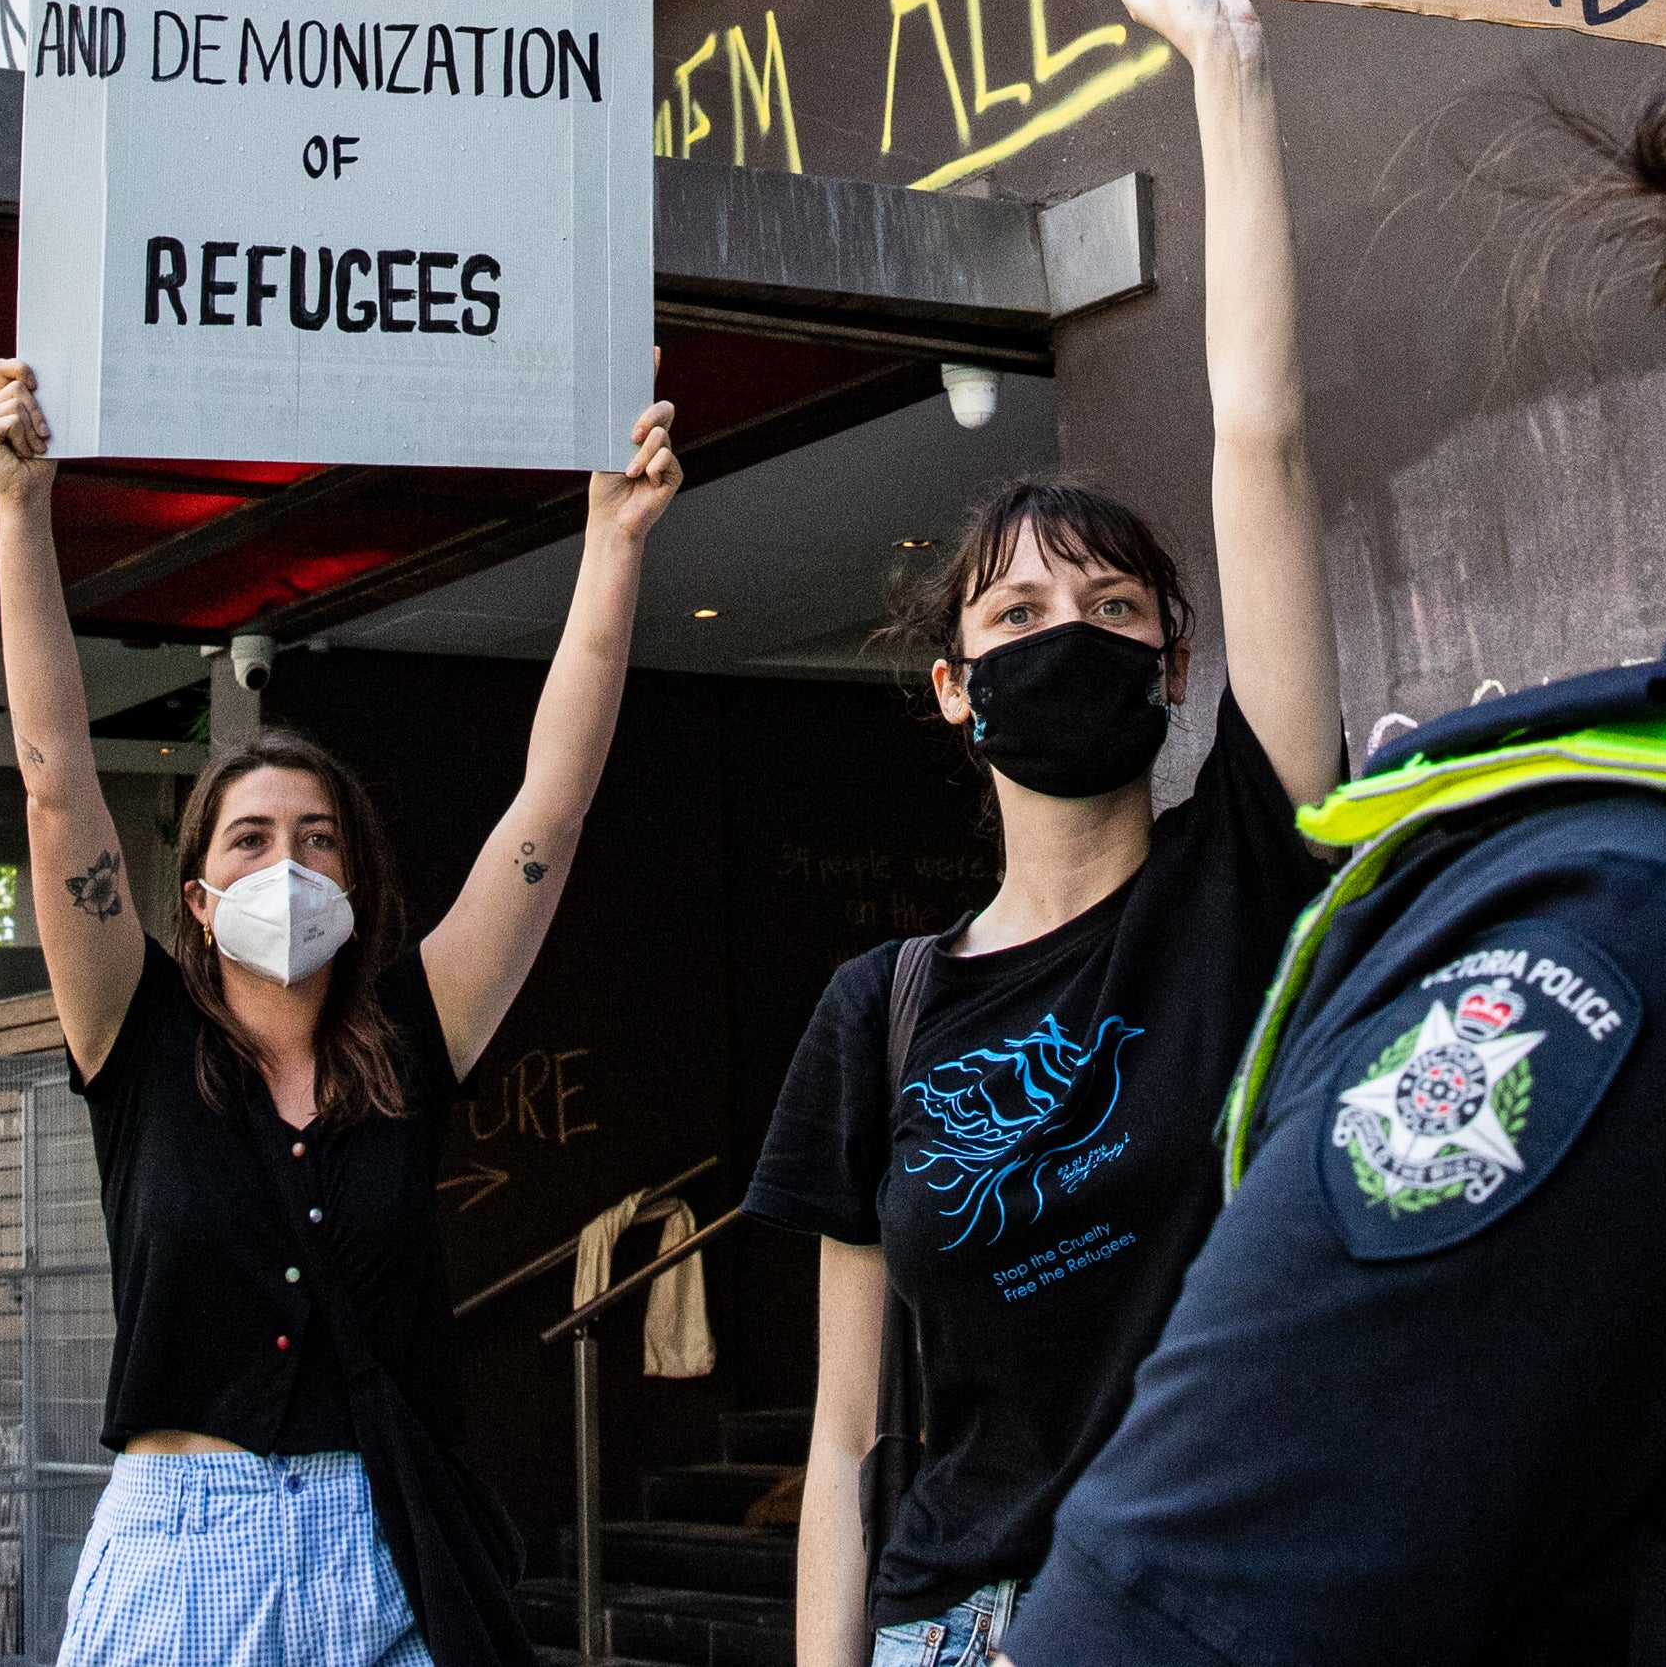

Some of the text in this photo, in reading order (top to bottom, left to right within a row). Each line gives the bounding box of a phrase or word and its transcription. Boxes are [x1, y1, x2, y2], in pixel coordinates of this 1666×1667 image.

[35, 1, 126, 78] AND
[151, 10, 602, 102] DEMONIZATION
[303, 135, 360, 180] OF
[144, 236, 501, 336] REFUGEES
[1527, 958, 1622, 1041] POLICE
[993, 1223, 1111, 1286] Stop the Cruelty
[1003, 1232, 1136, 1302] Free the Refugees
